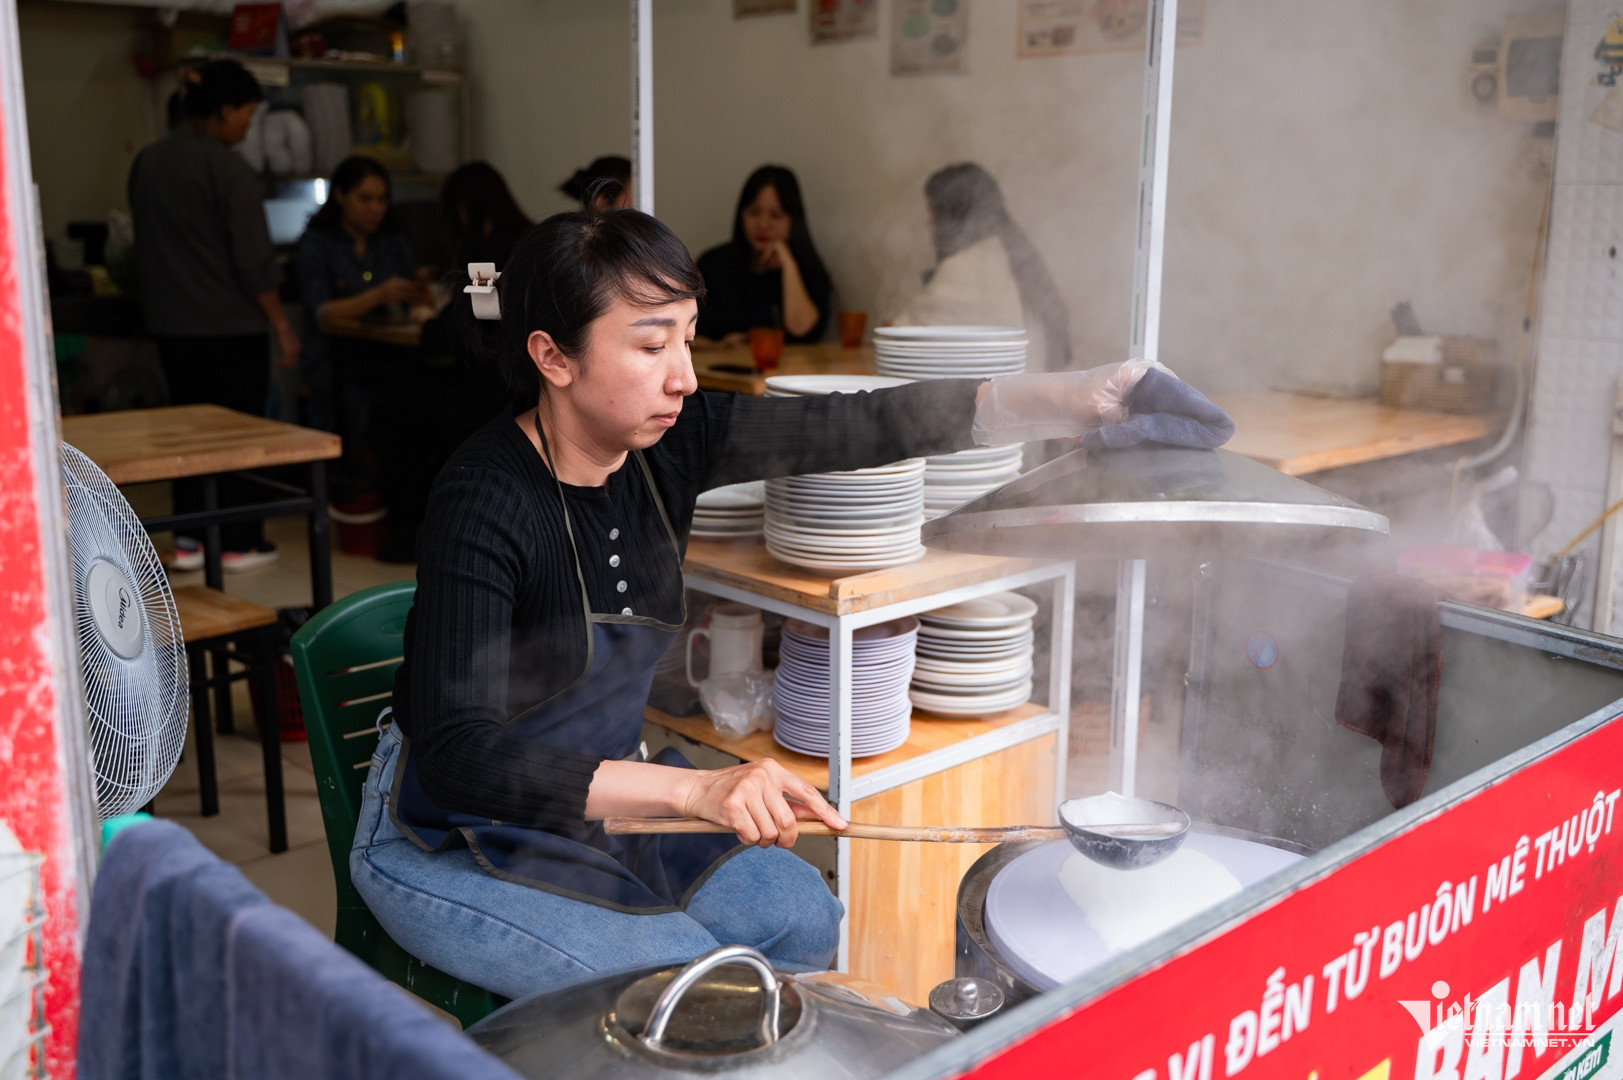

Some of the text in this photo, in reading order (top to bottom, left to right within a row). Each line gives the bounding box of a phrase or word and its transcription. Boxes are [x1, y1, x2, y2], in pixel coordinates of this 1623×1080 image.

[118, 587, 131, 629] Midea
[1224, 965, 1315, 1078] ĐẾN
[1322, 925, 1381, 1015] TỪ
[1379, 875, 1478, 980] BUÔN
[1482, 835, 1530, 914] MÊ
[1534, 788, 1622, 880] THUỘT
